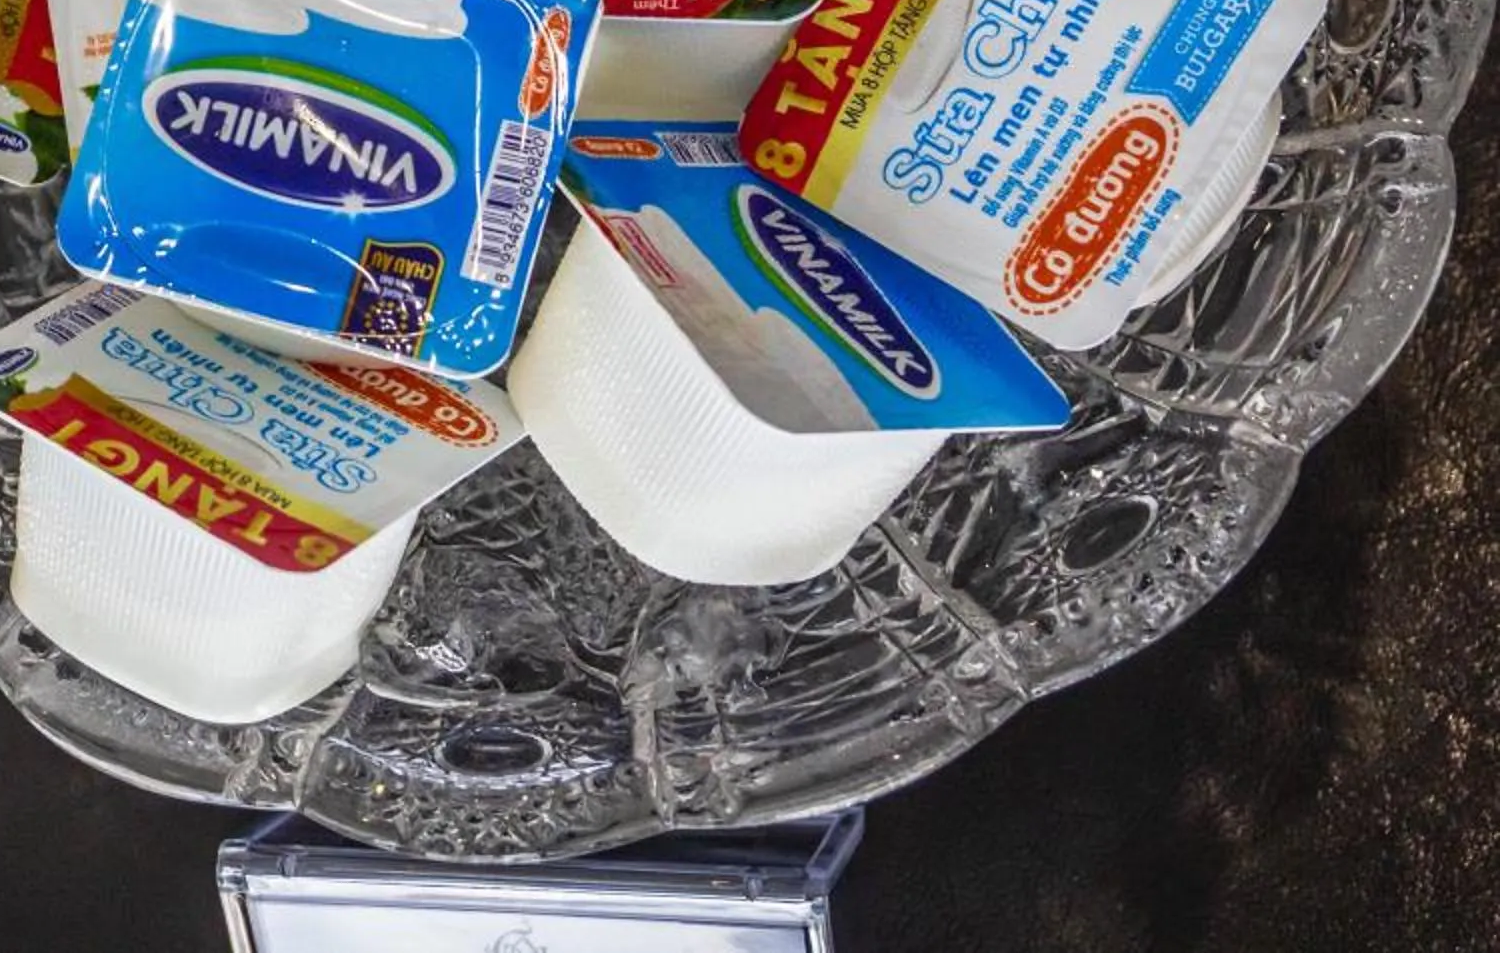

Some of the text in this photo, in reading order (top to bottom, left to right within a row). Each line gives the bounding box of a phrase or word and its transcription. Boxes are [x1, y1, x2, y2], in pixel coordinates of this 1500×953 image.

[841, 86, 869, 131] MUA
[861, 74, 881, 92] 8
[950, 150, 996, 204] Lên
[993, 86, 1042, 152] men
[1035, 40, 1073, 82] tự
[1008, 133, 1045, 177] Vitamin
[1047, 94, 1070, 117] D3
[167, 89, 417, 192] VINAMILK
[755, 137, 807, 179] 8
[882, 85, 996, 203] Sữa
[494, 132, 549, 285] 8 934673 606820
[1023, 127, 1159, 299] Có đường
[760, 208, 927, 378] VINAMILK
[102, 325, 255, 425] Chua
[147, 326, 222, 379] nhiên
[49, 420, 86, 444] 1
[261, 390, 324, 429] men
[328, 424, 381, 461] Lên
[255, 484, 290, 508] MUA
[294, 538, 337, 567] 8
